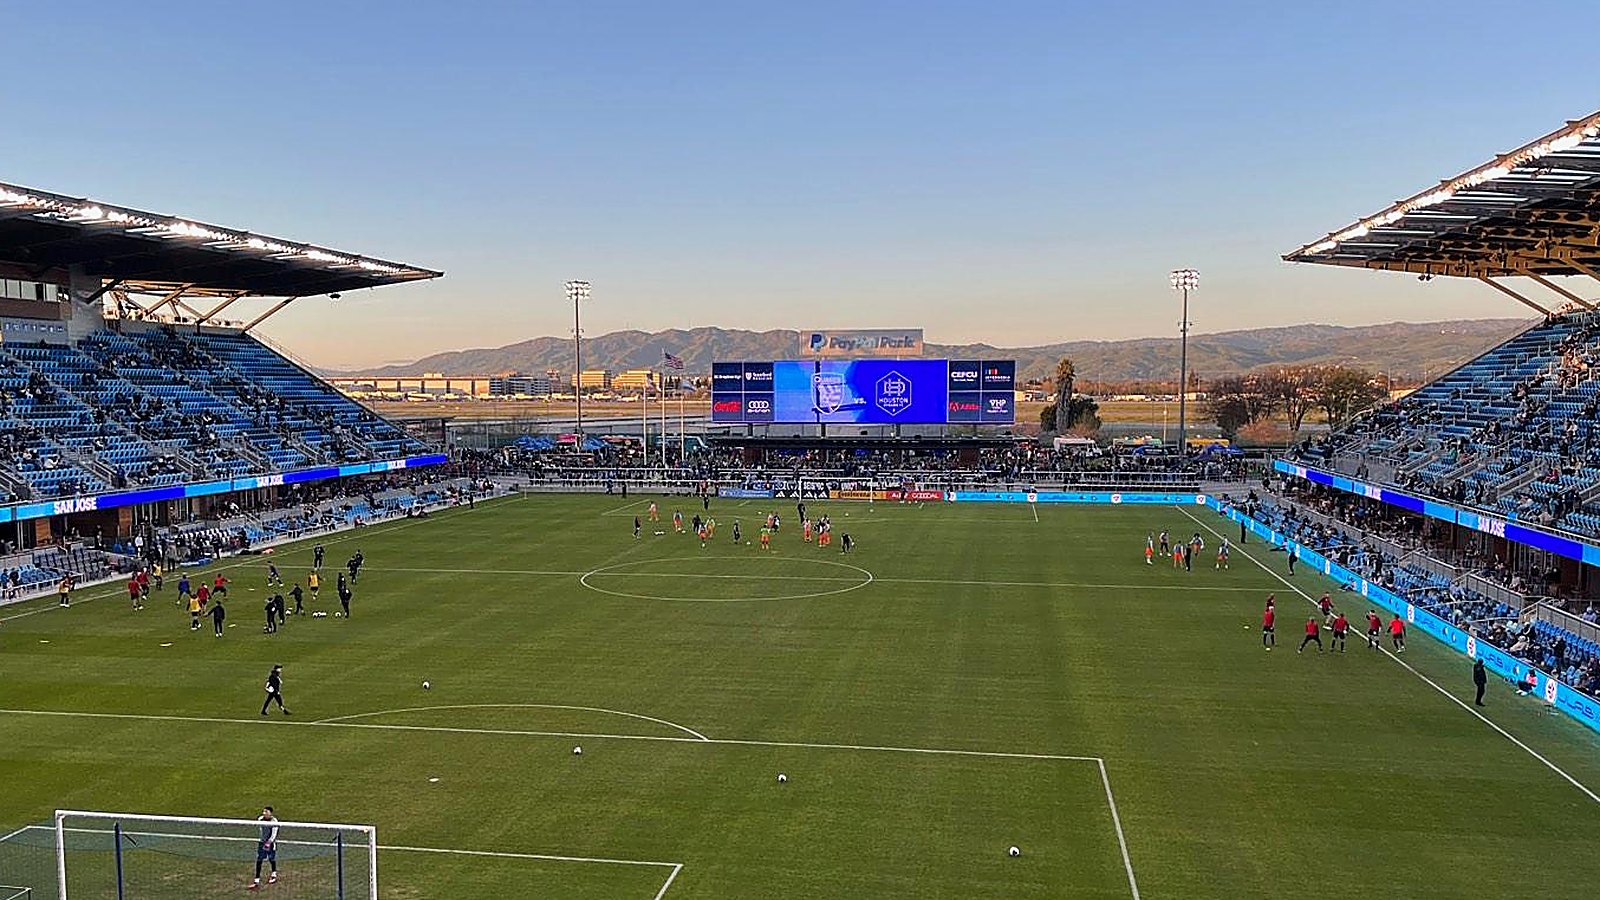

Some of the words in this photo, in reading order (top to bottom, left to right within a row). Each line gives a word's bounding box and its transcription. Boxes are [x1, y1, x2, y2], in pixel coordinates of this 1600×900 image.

[829, 336, 877, 351] PayPal
[880, 336, 917, 348] Park
[54, 499, 74, 515] SAN
[75, 496, 97, 512] JOSE
[1478, 515, 1490, 533] SAN
[1490, 518, 1506, 538] JOSE
